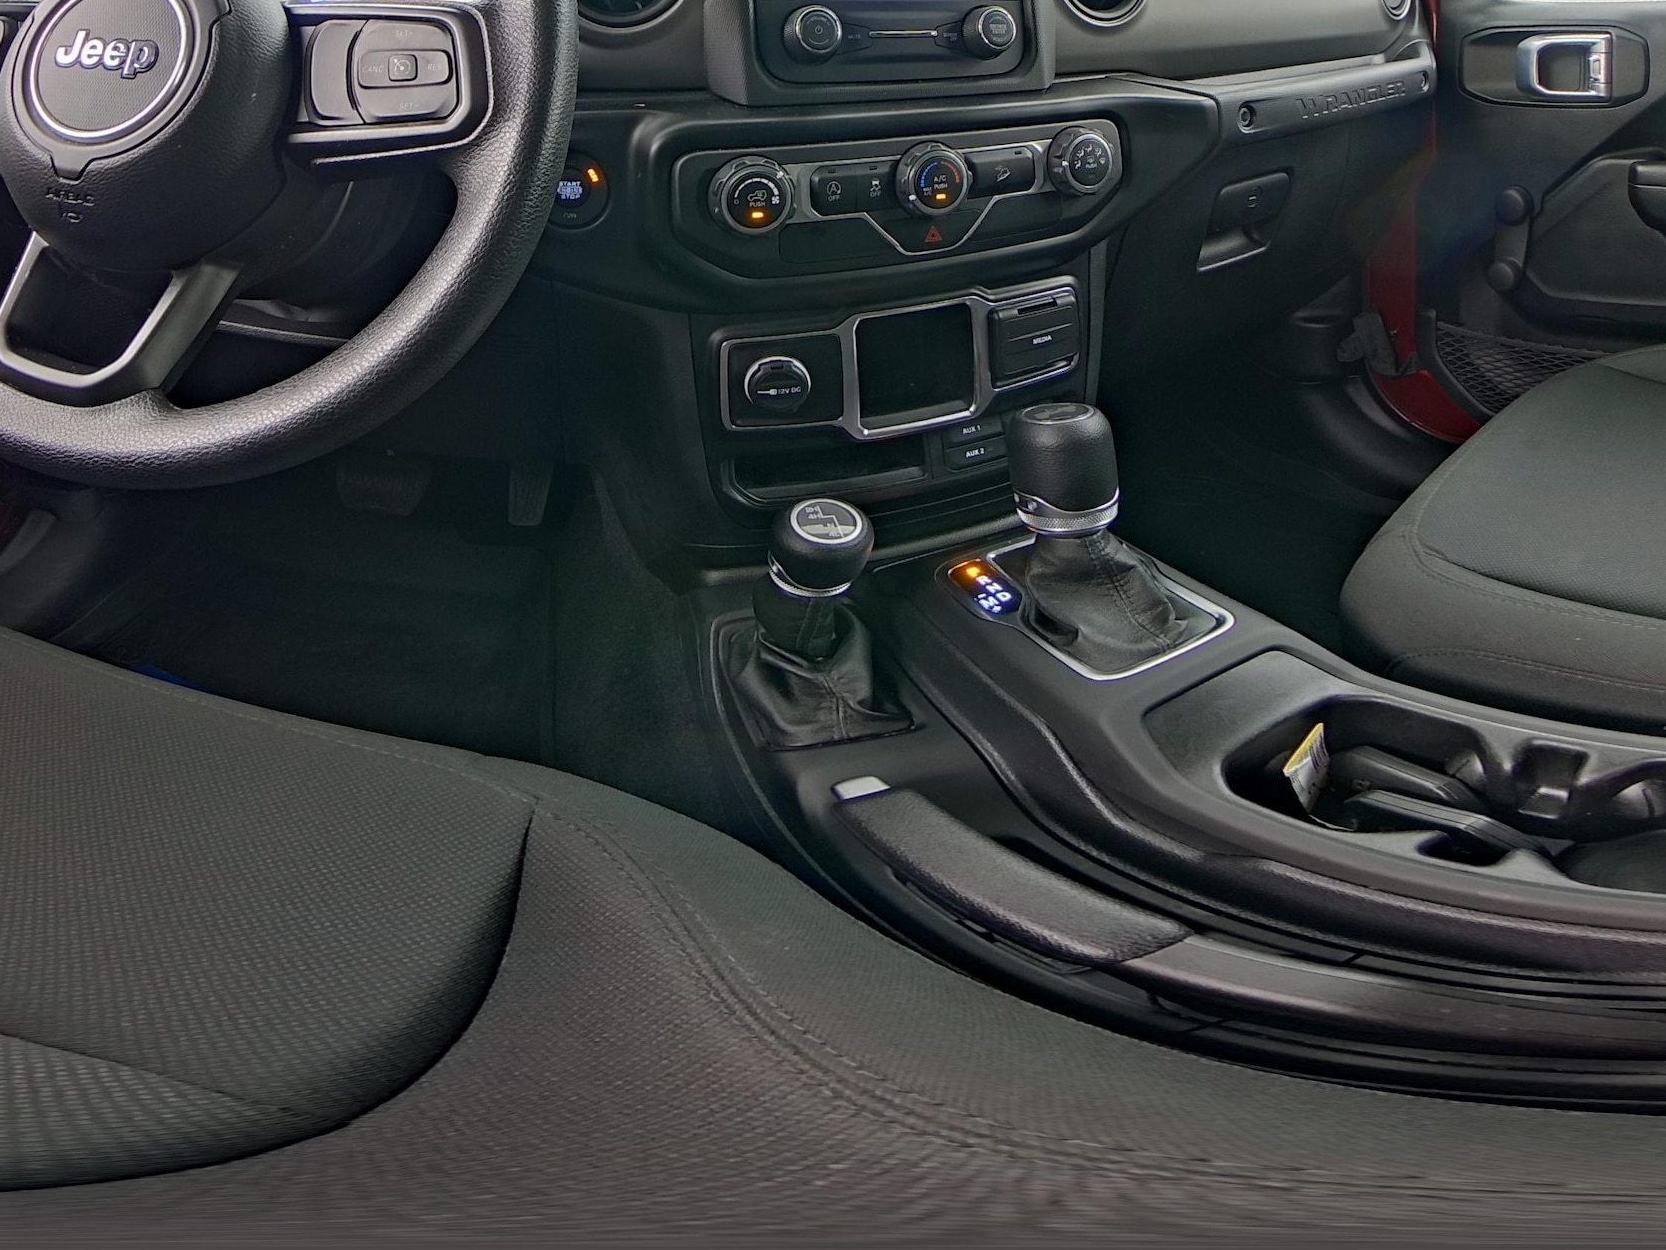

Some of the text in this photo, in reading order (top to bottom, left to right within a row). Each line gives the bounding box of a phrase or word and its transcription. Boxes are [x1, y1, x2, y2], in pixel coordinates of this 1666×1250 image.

[55, 28, 159, 79] Jeep
[362, 65, 384, 73] CANC
[1295, 80, 1406, 119] WRANGLER
[933, 174, 946, 183] A/C
[1032, 334, 1052, 344] MEDIA
[778, 387, 790, 395] 12V
[962, 426, 977, 435] AUX
[965, 449, 979, 458] AUX
[975, 575, 992, 585] R
[985, 582, 1003, 593] N
[995, 591, 1012, 602] D
